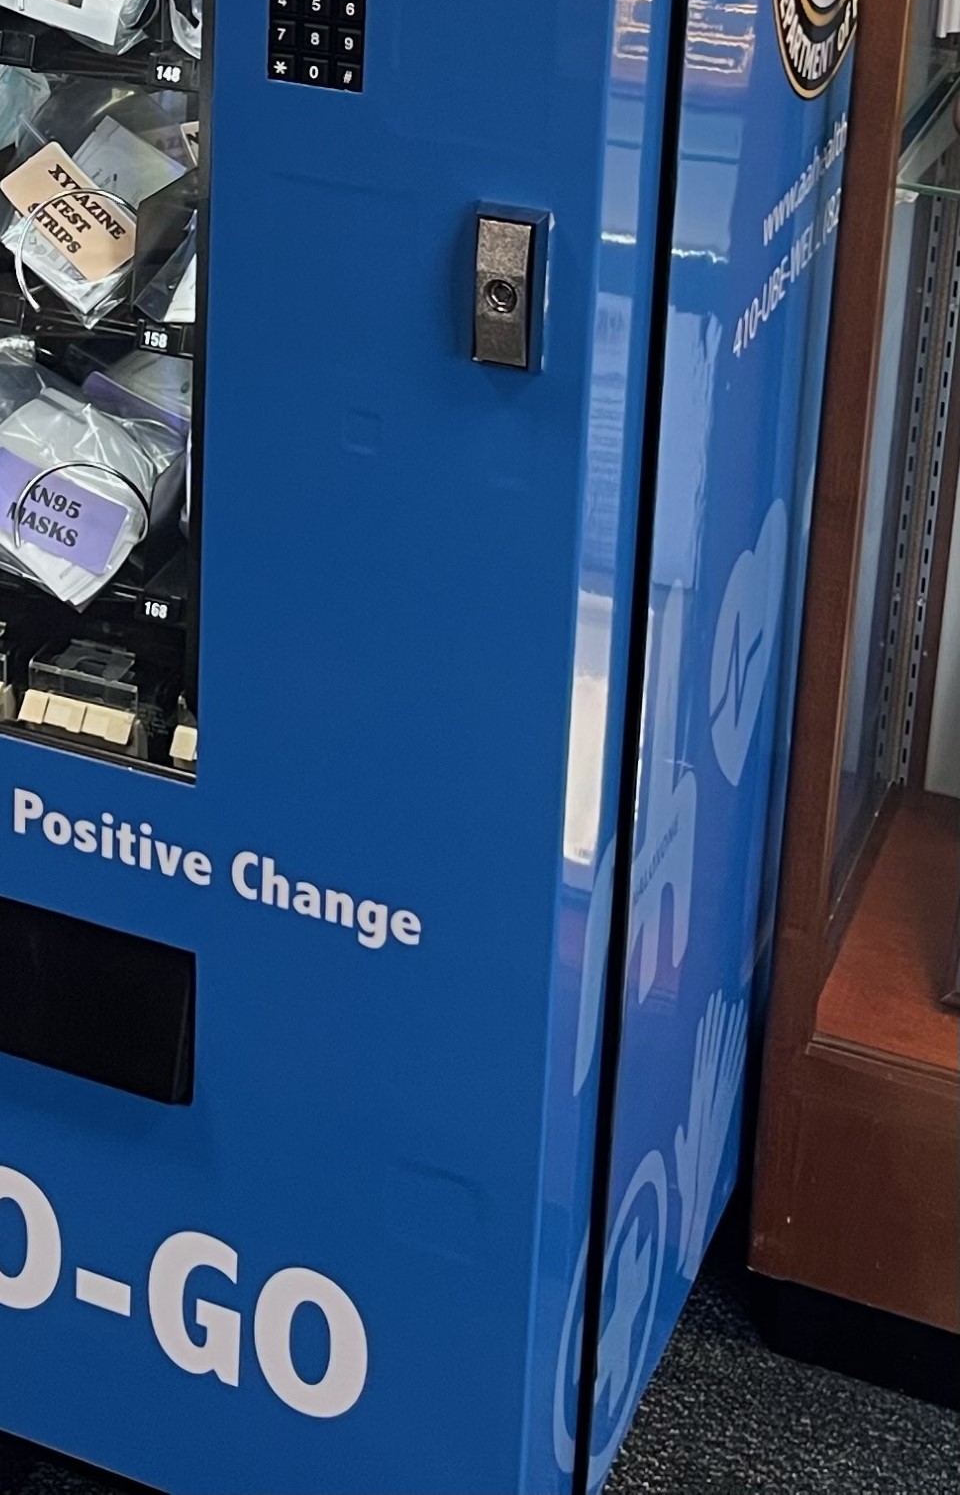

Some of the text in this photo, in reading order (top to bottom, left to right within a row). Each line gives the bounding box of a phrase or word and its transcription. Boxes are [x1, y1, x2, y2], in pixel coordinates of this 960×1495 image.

[345, 3, 355, 15] 6
[277, 28, 354, 50] 7 8 9
[156, 66, 181, 83] 148
[309, 66, 318, 79] 0
[52, 199, 91, 233] TEST
[27, 203, 81, 253] STRIPS
[144, 332, 167, 348] 158
[28, 480, 82, 519] KN95
[7, 502, 78, 548] MASKS
[145, 602, 168, 619] 168
[14, 788, 212, 886] Positive
[231, 851, 422, 949] Change
